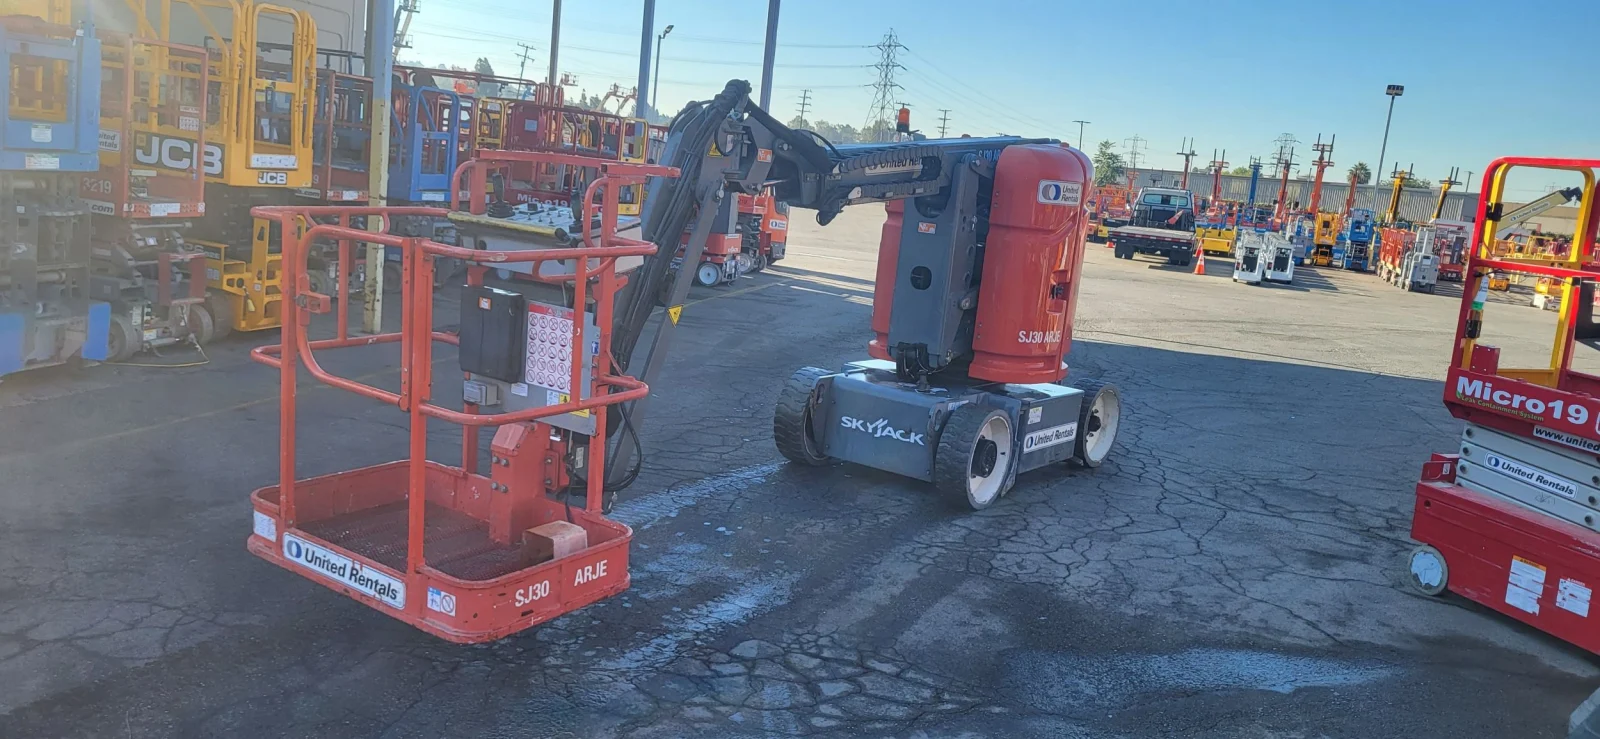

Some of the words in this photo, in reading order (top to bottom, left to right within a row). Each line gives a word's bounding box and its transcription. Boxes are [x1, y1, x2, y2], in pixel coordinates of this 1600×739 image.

[135, 136, 222, 175] JCB
[83, 177, 112, 194] 3219
[258, 172, 287, 184] JCB
[1061, 194, 1079, 202] Rentals
[1063, 184, 1079, 194] United
[517, 193, 568, 207] Mico19
[1018, 330, 1043, 343] SJ30
[1043, 331, 1061, 343] ARJE
[1458, 376, 1588, 425] Micro19
[1478, 400, 1518, 416] Containment
[1519, 410, 1544, 421] System
[841, 416, 925, 446] SKYJACK
[1034, 431, 1055, 446] United
[1054, 426, 1075, 440] Rentals
[1501, 461, 1534, 480] United
[1535, 474, 1575, 496] Rentals
[305, 547, 347, 578] United
[349, 566, 398, 600] Rentals
[515, 580, 550, 607] SJ30
[574, 560, 608, 587] ARJE
